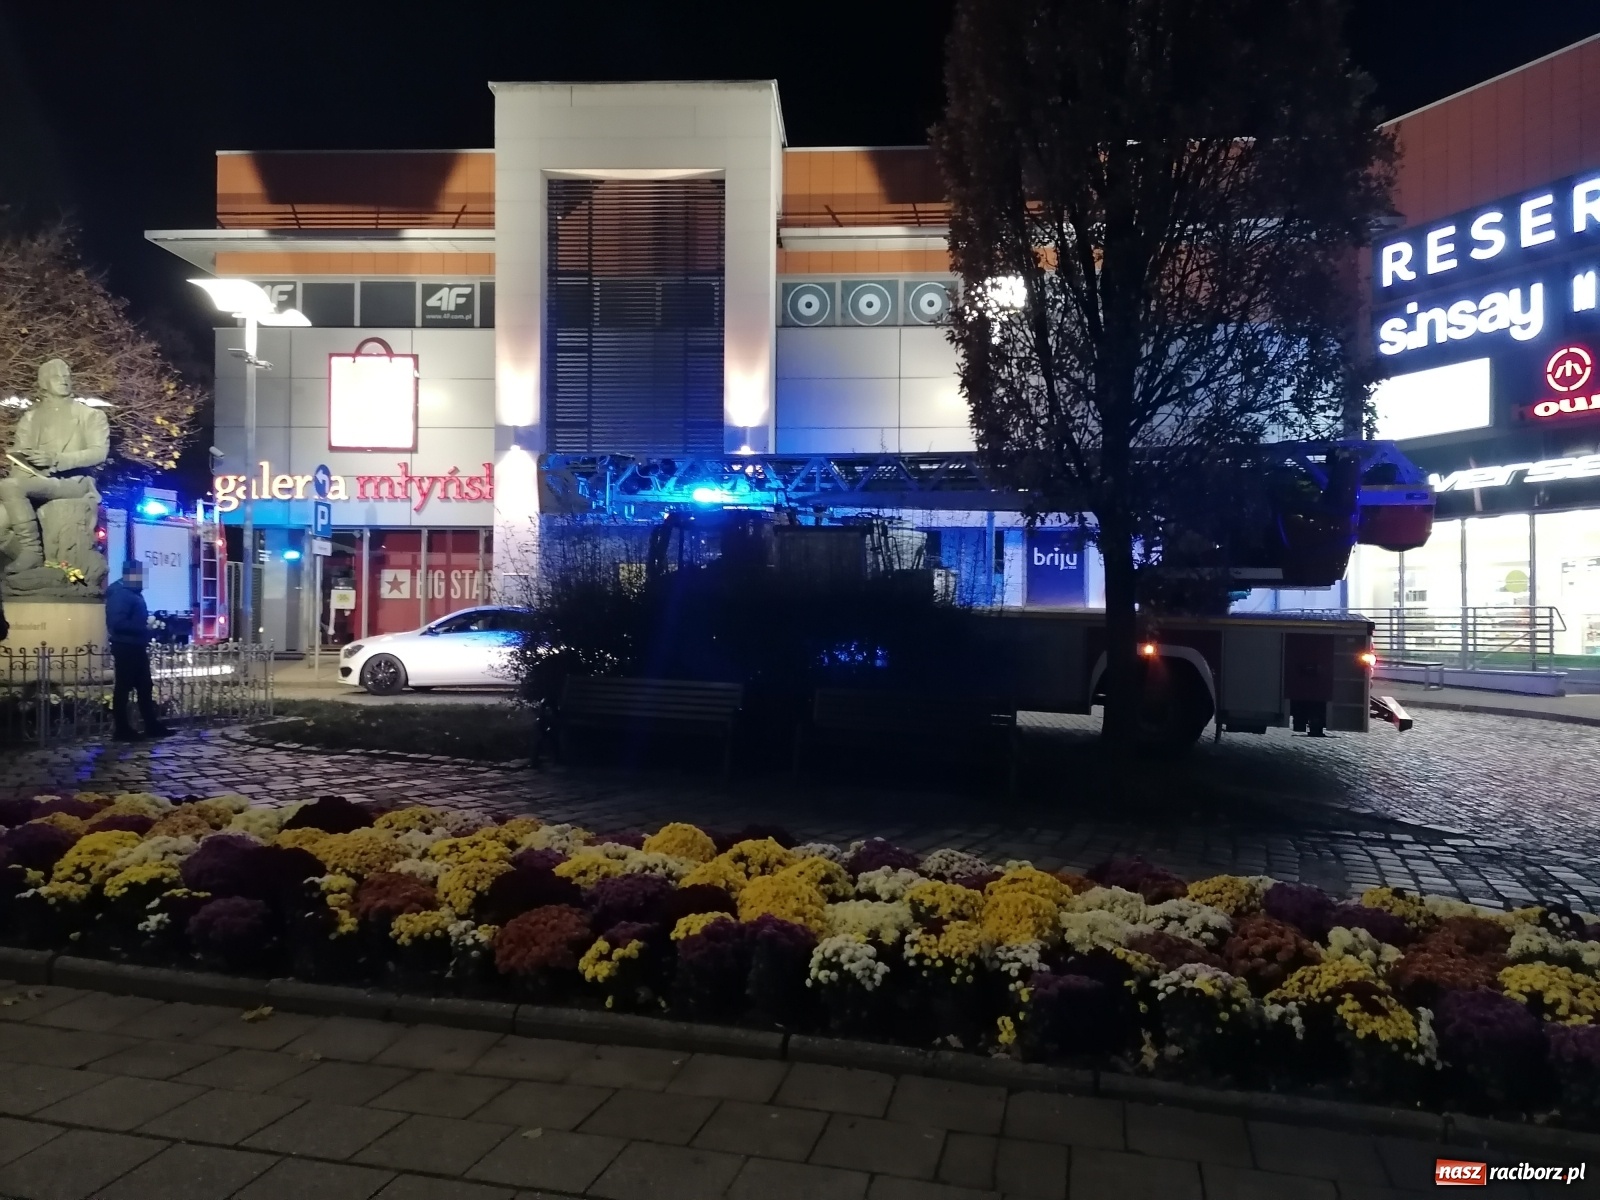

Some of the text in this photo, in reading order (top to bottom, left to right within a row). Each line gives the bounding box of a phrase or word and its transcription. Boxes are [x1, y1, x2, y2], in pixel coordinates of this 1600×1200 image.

[425, 287, 472, 311] 4F
[1379, 282, 1544, 355] sinsay
[214, 461, 350, 512] galera
[1033, 546, 1078, 571] briju
